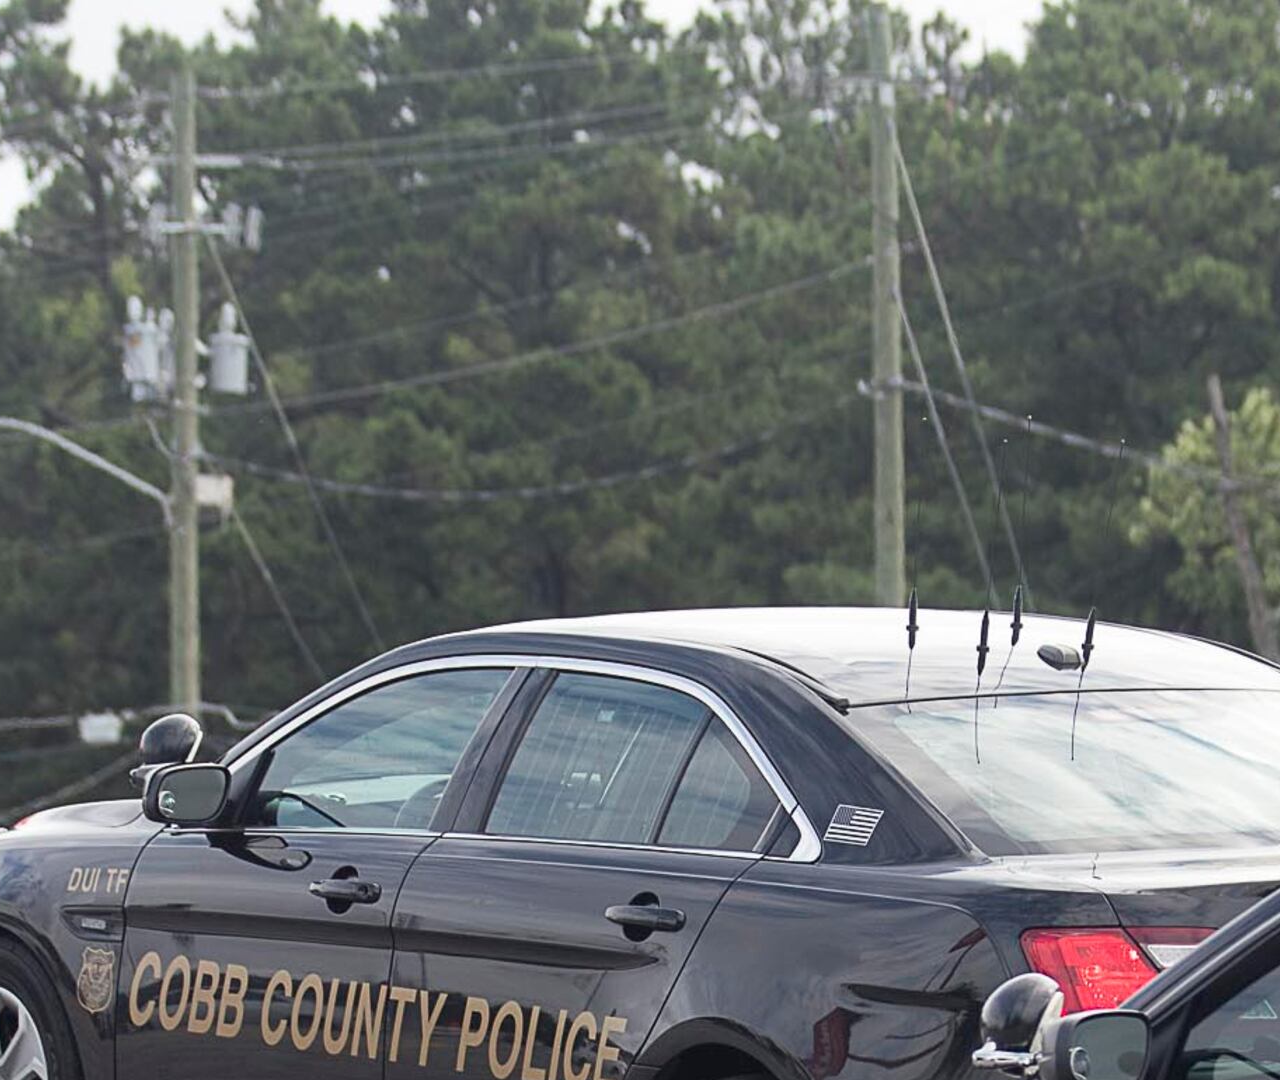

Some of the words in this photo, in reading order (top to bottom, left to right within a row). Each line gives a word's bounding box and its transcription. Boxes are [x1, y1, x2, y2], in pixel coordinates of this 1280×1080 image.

[67, 867, 101, 893] DUI
[106, 869, 129, 893] TF
[129, 951, 249, 1039] COBB
[260, 969, 448, 1067] COUNTY
